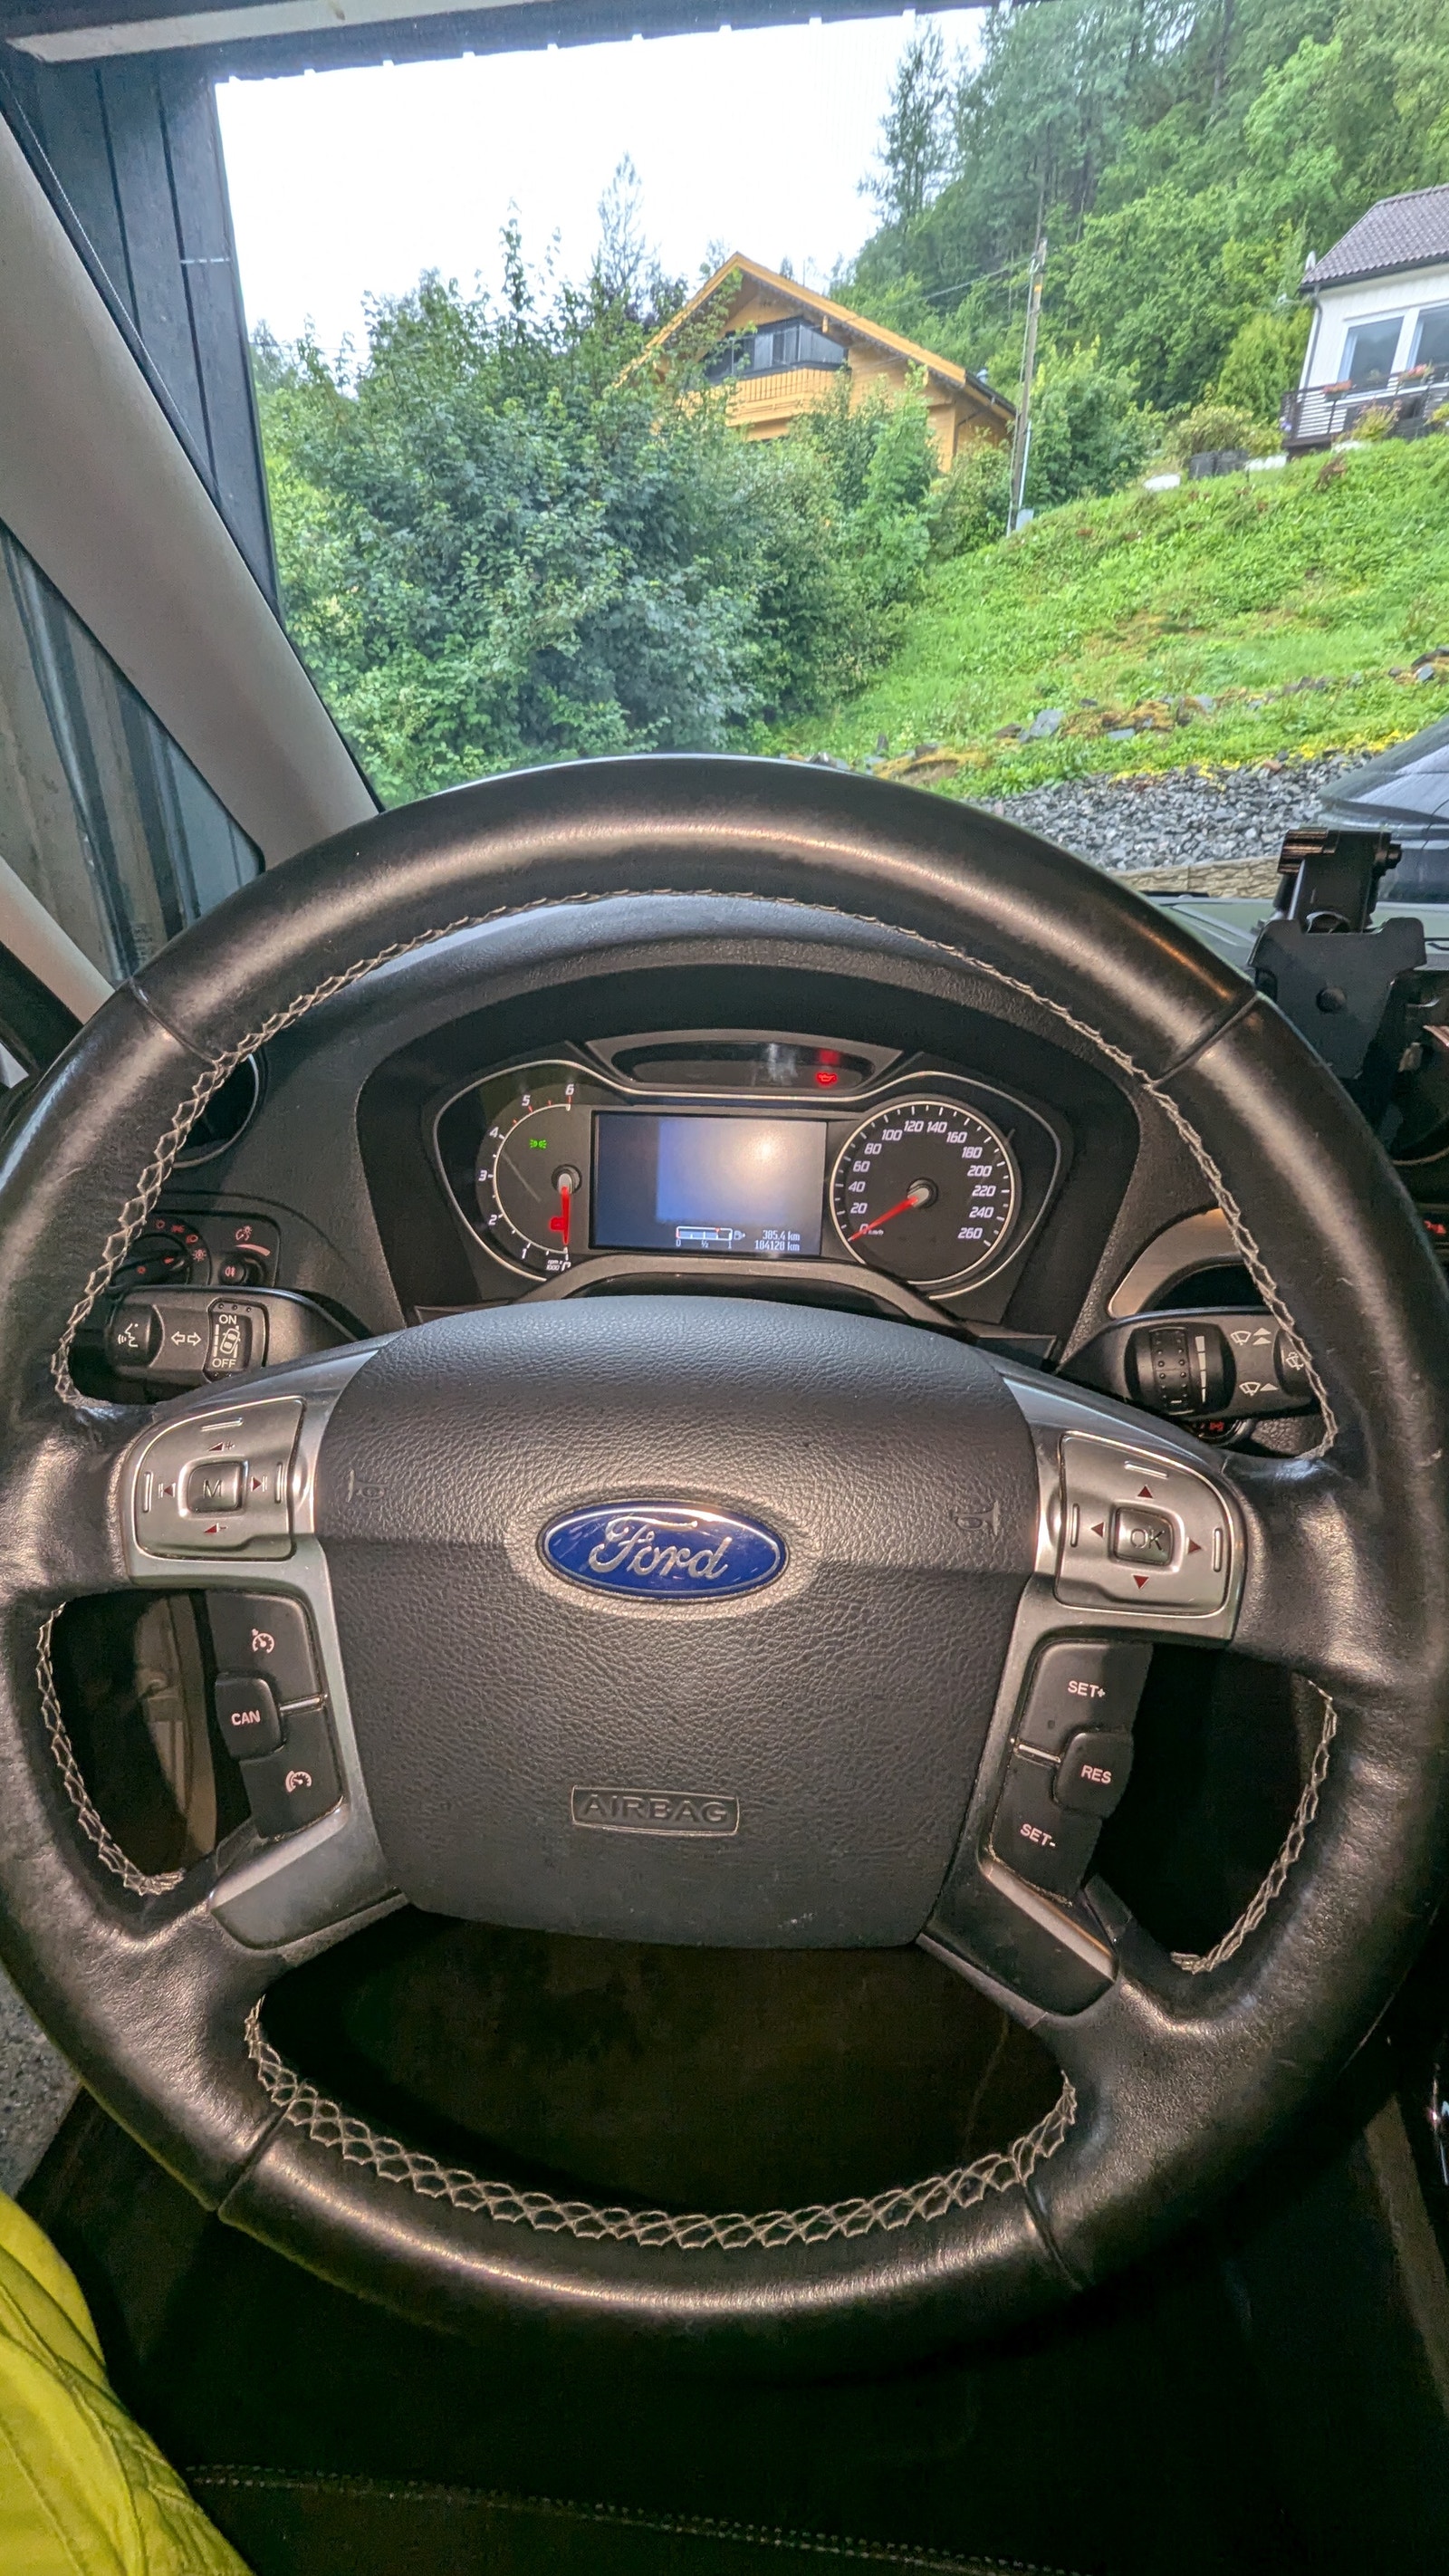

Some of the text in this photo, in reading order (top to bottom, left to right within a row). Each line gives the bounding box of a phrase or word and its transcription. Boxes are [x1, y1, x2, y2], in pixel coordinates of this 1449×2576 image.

[565, 1083, 575, 1096] 6
[522, 1094, 531, 1107] 5
[904, 1120, 924, 1132] 120
[926, 1120, 948, 1133] 140
[489, 1127, 499, 1139] 4
[881, 1129, 903, 1141] 100
[945, 1131, 967, 1144] 160
[864, 1142, 882, 1155] 80
[961, 1146, 983, 1158] 180
[852, 1160, 870, 1173] 60
[966, 1165, 993, 1177] 200
[478, 1169, 488, 1182] 3
[848, 1181, 866, 1193] 40
[971, 1185, 996, 1197] 220
[849, 1202, 868, 1214] 20
[968, 1206, 994, 1218] 240
[488, 1214, 498, 1226] 2
[762, 1229, 801, 1241] 385.4 km
[957, 1227, 984, 1239] 260
[727, 1240, 733, 1249] 1
[754, 1240, 801, 1252] 184128 km
[521, 1247, 527, 1260] 1
[218, 1313, 238, 1326] ON
[211, 1358, 236, 1369] OFF
[202, 1478, 223, 1499] M
[1131, 1526, 1166, 1551] OK
[589, 1515, 733, 1581] Ford
[1067, 1680, 1106, 1698] SET+
[231, 1709, 261, 1726] CAN
[1080, 1764, 1112, 1785] RES
[579, 1793, 727, 1823] AIRBAG
[1020, 1822, 1056, 1849] SET-
